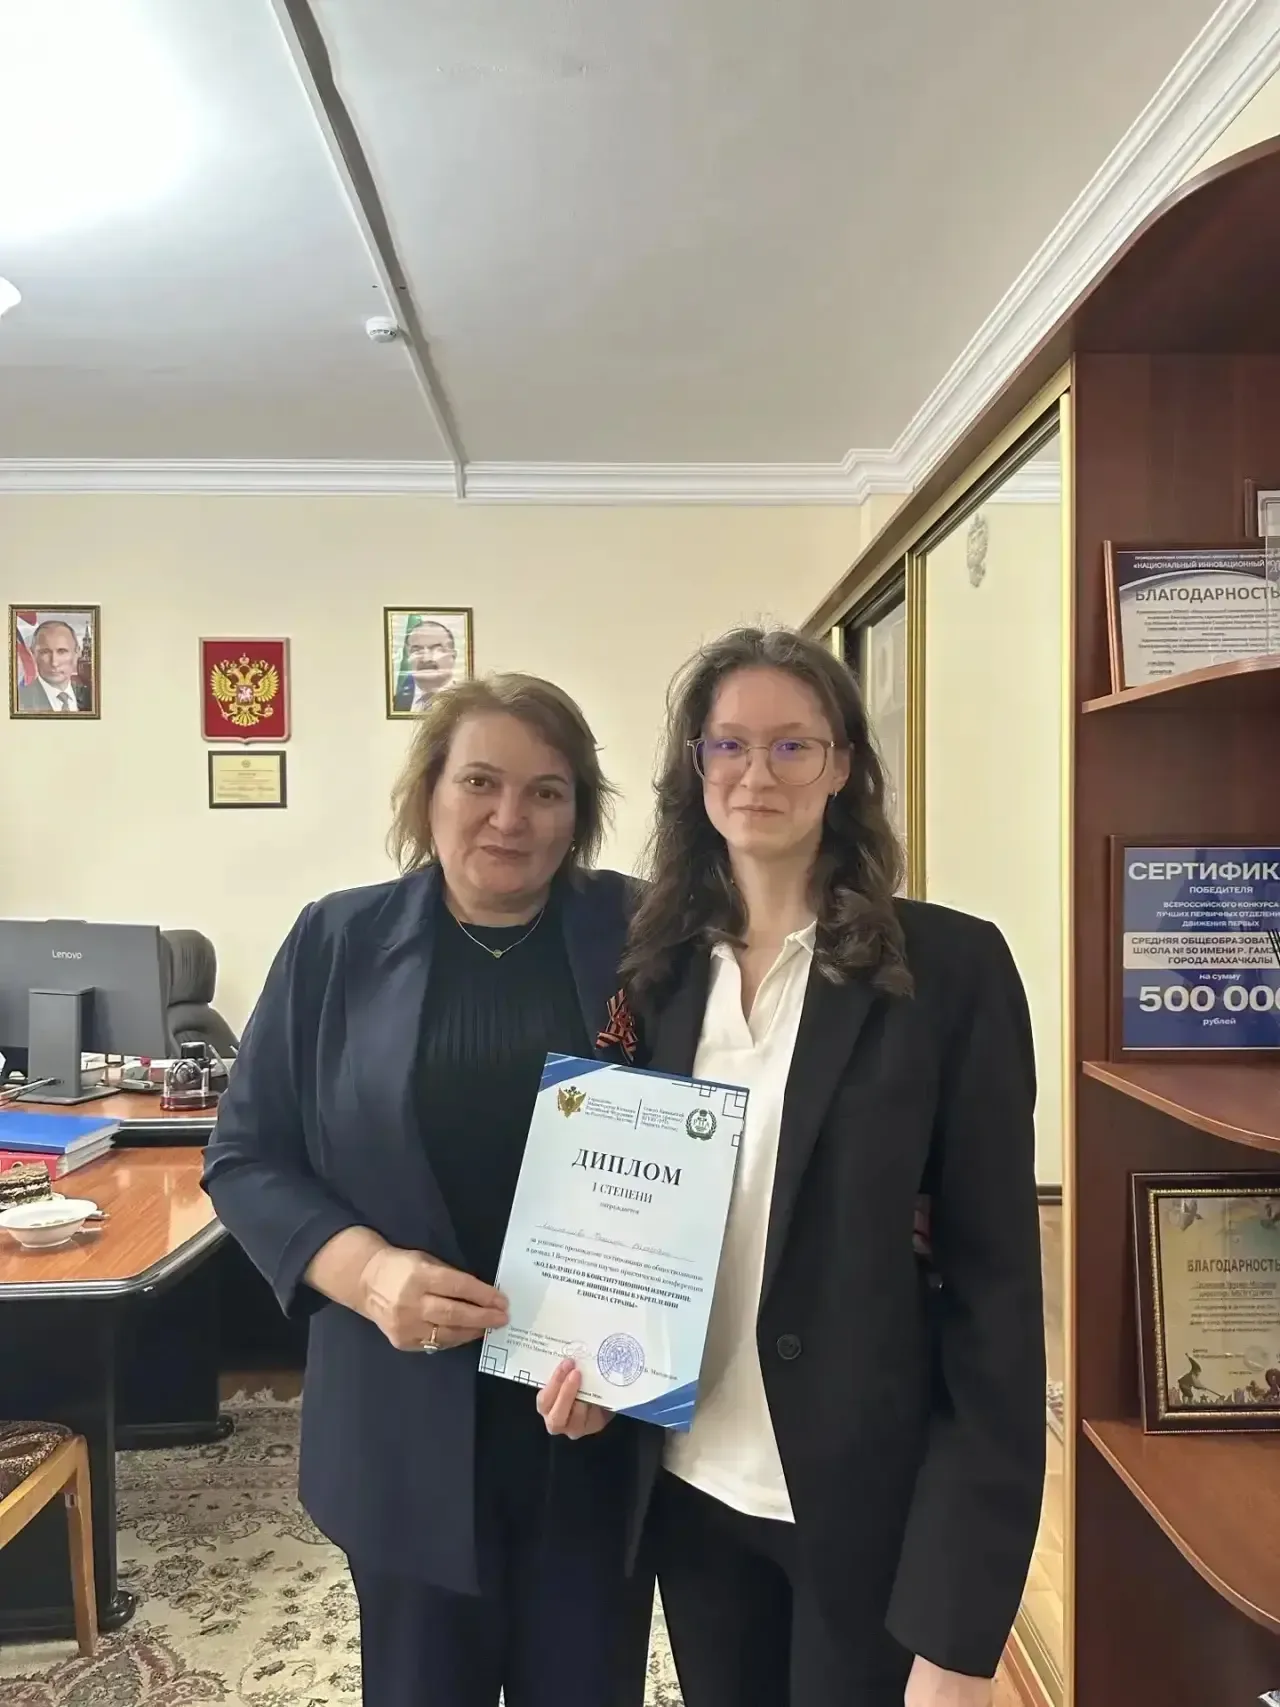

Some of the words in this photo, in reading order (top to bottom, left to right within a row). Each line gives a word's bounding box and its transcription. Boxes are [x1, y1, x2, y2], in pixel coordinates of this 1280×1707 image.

[1135, 587, 1280, 603] БЛАГОДАРНОСТЬ
[1189, 886, 1253, 894] ПОБЕДИТЕЛЯ
[1182, 920, 1227, 928] ДВИЖЕНИЯ
[1132, 937, 1179, 945] СРЕДНЯЯ
[51, 949, 83, 960] Lenovo
[1168, 956, 1209, 965] ГОРОДА
[1210, 956, 1273, 964] МАХАЧКАЛЫ
[1139, 985, 1216, 1012] 500
[1223, 985, 1280, 1012] 00
[1203, 1018, 1236, 1027] рублей
[572, 1148, 683, 1186] ДИПЛОМ
[600, 1184, 653, 1204] СТЕПЕНИ
[1187, 1259, 1280, 1273] БЛАГОДАРНОСТЬ
